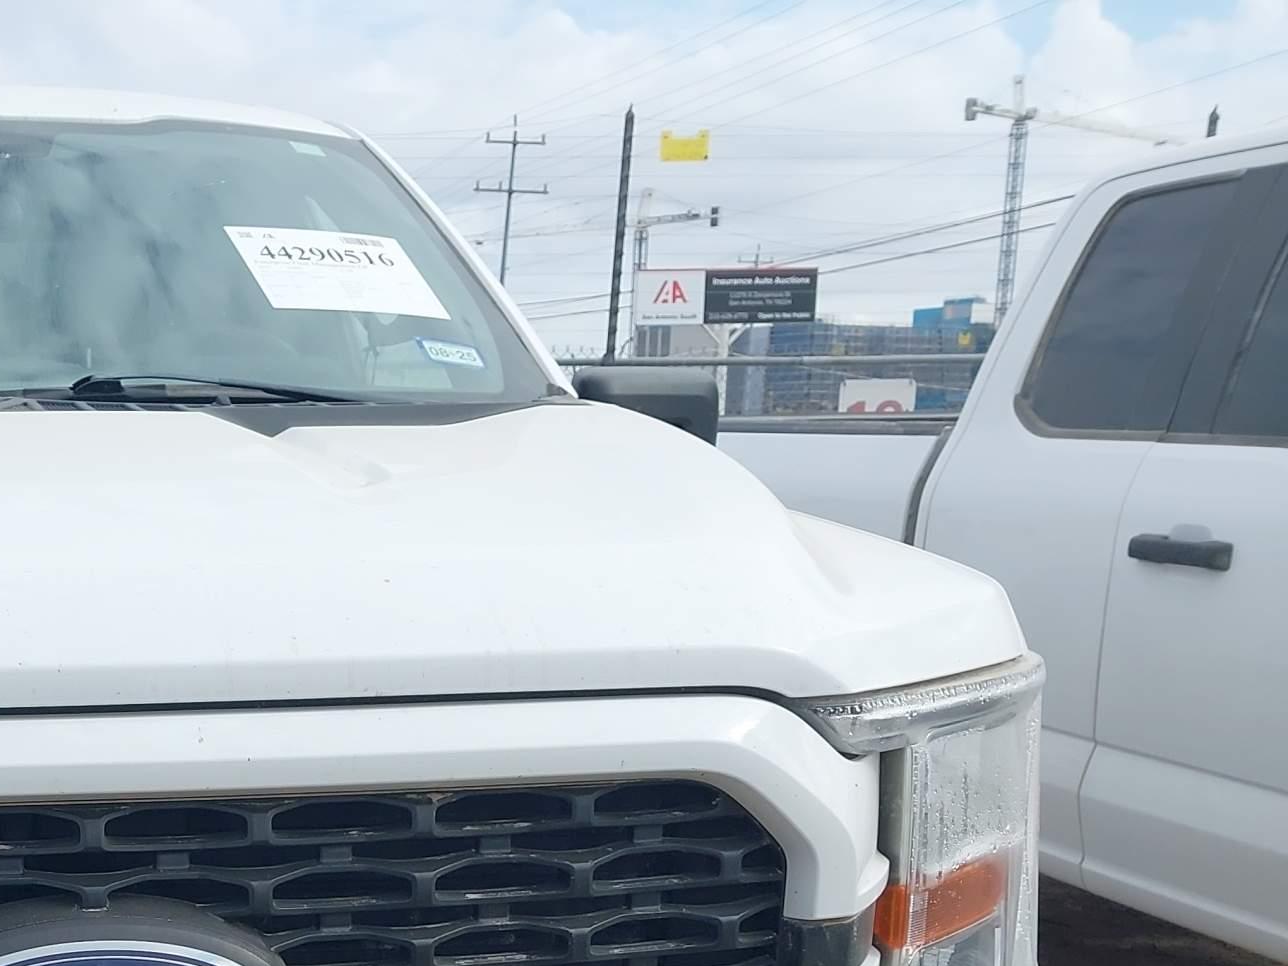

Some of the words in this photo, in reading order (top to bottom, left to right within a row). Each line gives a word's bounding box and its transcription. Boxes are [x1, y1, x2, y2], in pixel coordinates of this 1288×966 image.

[260, 245, 394, 267] 44290516
[754, 276, 773, 285] Auto
[774, 275, 810, 285] Auctions
